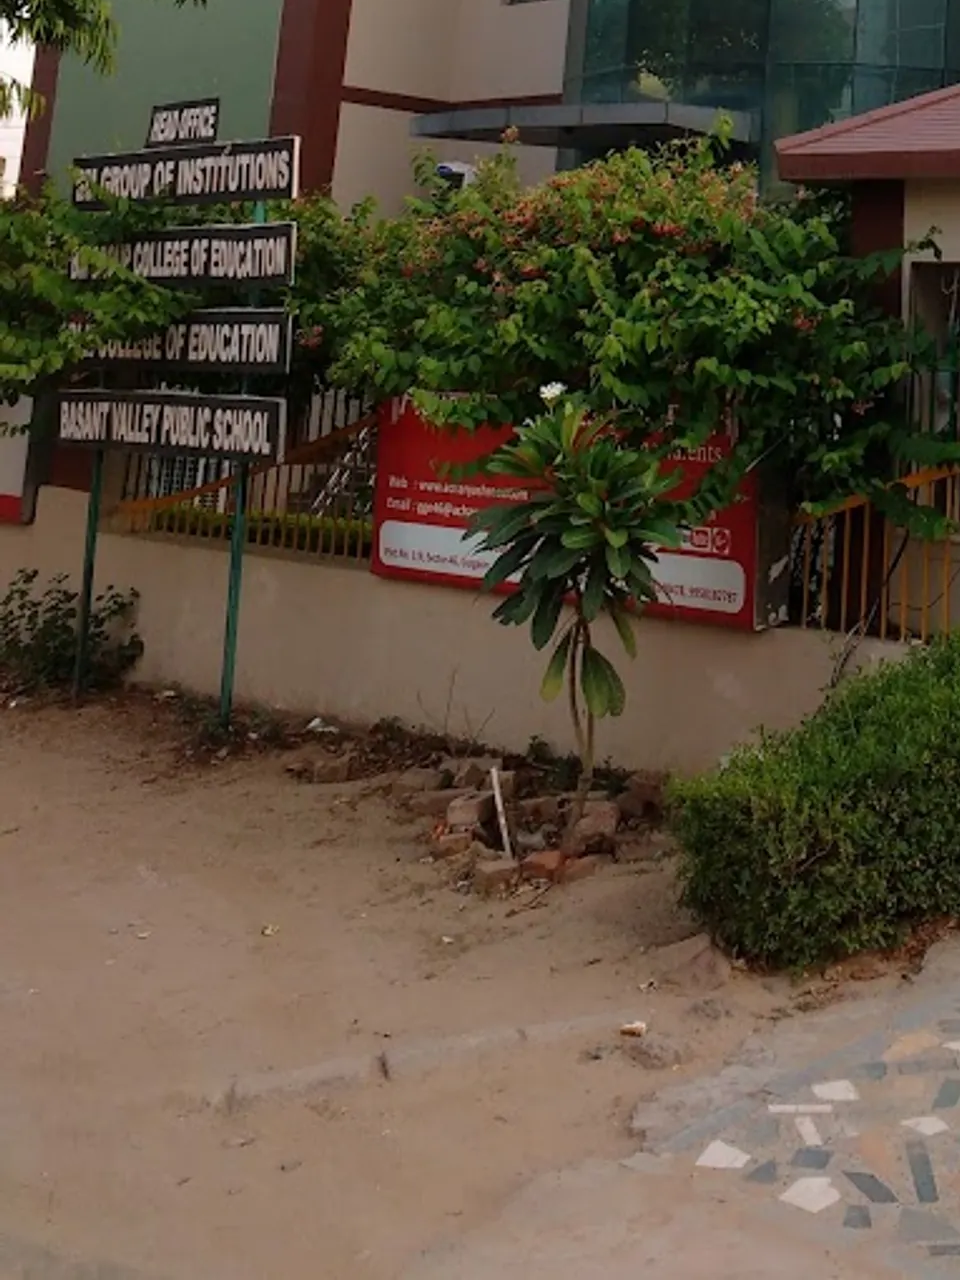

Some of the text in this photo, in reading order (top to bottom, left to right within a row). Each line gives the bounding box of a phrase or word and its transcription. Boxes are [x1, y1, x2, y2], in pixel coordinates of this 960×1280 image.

[179, 106, 216, 138] OFFICE
[100, 163, 150, 199] GROUP
[153, 160, 175, 195] OF
[177, 151, 290, 195] INSTITUTIONS
[133, 241, 189, 277] COLLEGE
[191, 239, 209, 276] OF
[210, 236, 287, 279] EDUCATION
[165, 324, 187, 360] OF
[188, 323, 280, 363] EDUCATION
[60, 401, 271, 456] BASANT VALLEY PUBLIC SCHOOL
